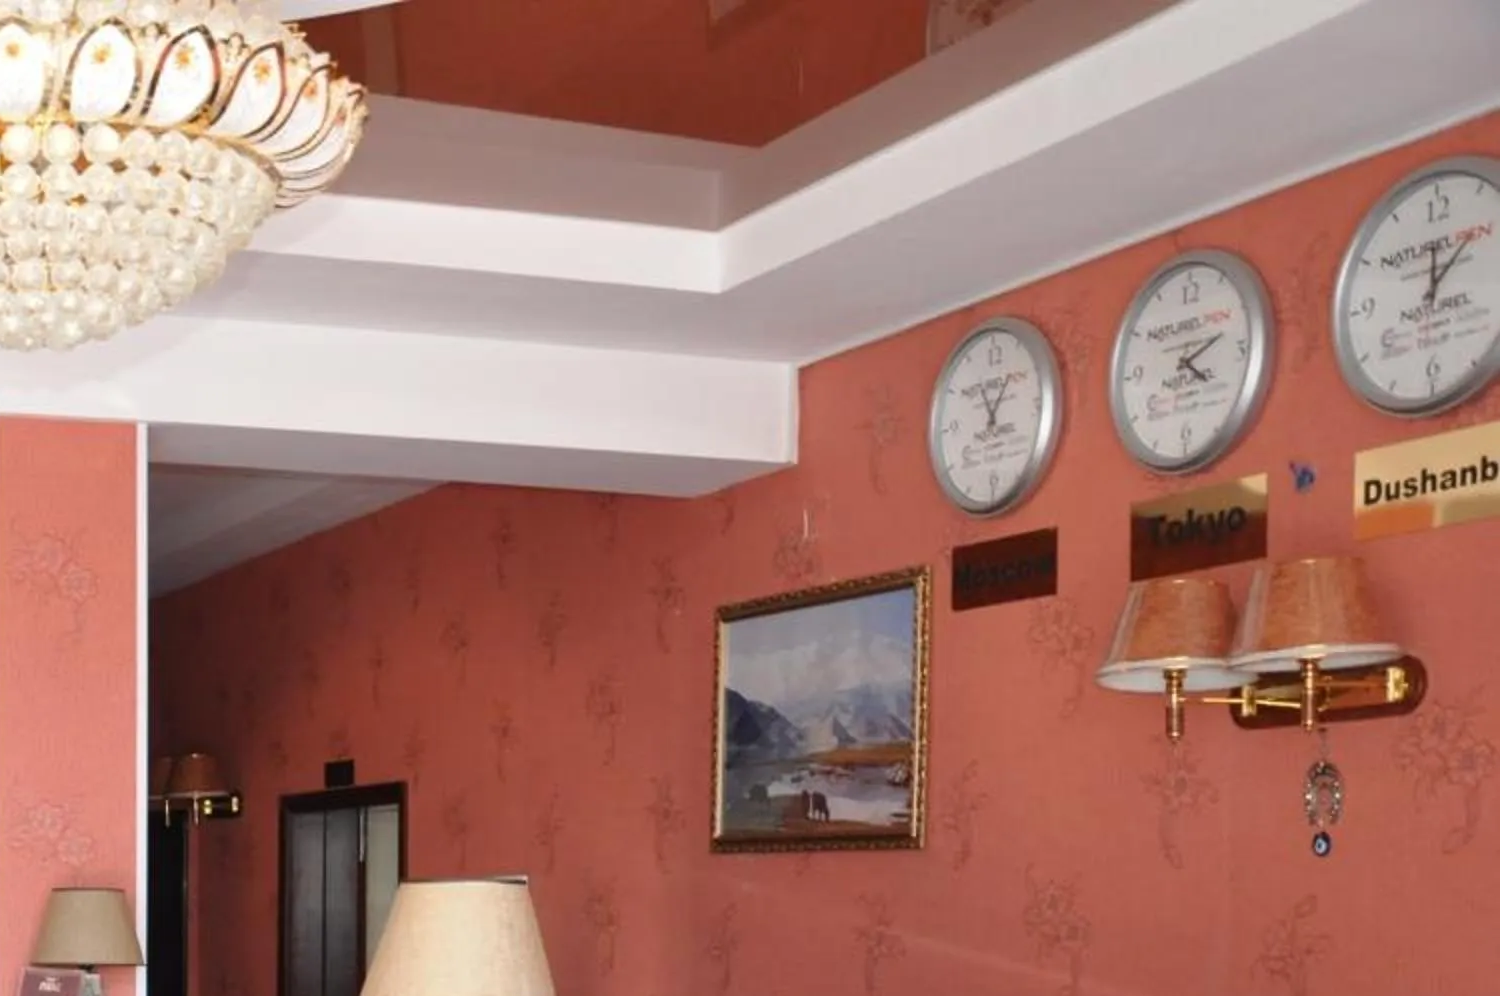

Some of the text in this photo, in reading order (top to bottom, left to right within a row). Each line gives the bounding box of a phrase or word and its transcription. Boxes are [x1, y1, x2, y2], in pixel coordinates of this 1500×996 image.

[1427, 195, 1451, 223] 12
[1182, 280, 1200, 305] 12
[1361, 297, 1376, 319] 9
[1132, 365, 1144, 381] 9
[1426, 354, 1441, 380] 6
[1180, 422, 1192, 442] 6
[1145, 506, 1247, 547] Tokyo
